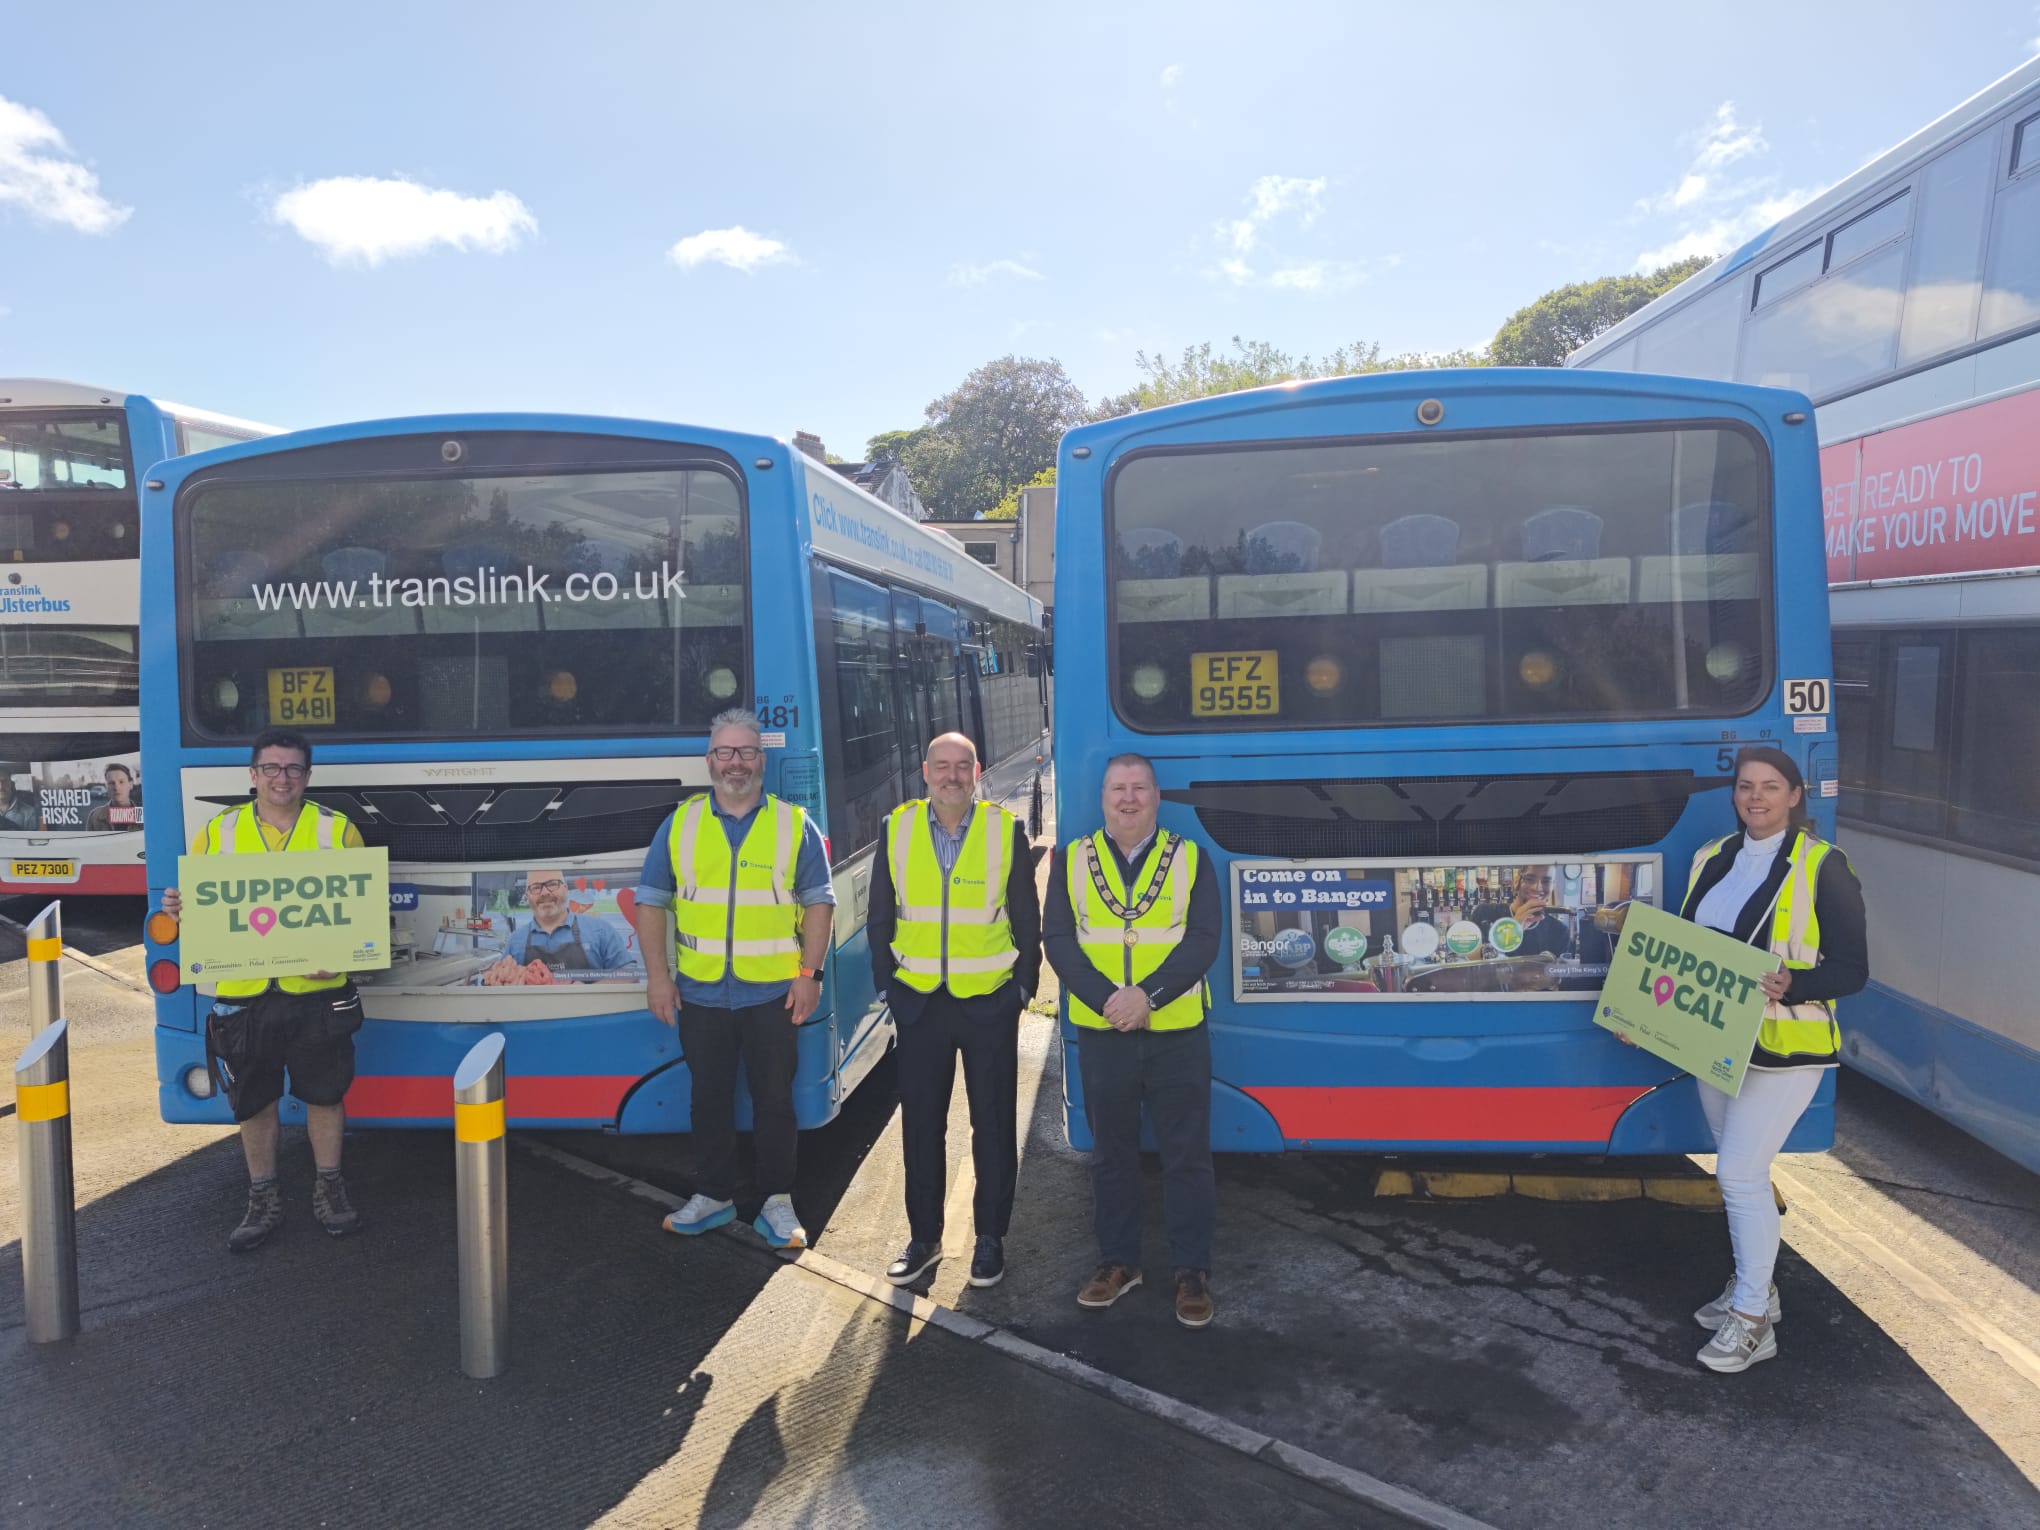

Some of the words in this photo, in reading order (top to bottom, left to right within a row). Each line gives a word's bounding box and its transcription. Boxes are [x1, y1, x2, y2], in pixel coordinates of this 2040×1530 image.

[1822, 481, 1857, 520] GET
[1863, 460, 1943, 513] READY
[1948, 452, 1982, 496] TO
[813, 492, 838, 534] Click
[1882, 507, 1947, 550] YOUR
[1955, 491, 2037, 542] MOVE
[0, 585, 41, 596] ranslink
[252, 561, 687, 611] www.translink.co.uk
[1209, 656, 1262, 682] EFZ
[281, 671, 327, 694] BFZ
[784, 695, 795, 703] 07
[1200, 685, 1271, 711] 9555
[1789, 681, 1825, 712] 50
[280, 697, 331, 720] 8481
[1760, 729, 1772, 738] 07
[424, 767, 496, 777] WRIGHT
[40, 789, 91, 807] SHARED
[42, 807, 83, 824] RISKS.
[16, 864, 38, 875] PEZ
[42, 863, 69, 875] 7300
[1243, 869, 1306, 883] Come
[1311, 869, 1341, 882] on
[196, 873, 373, 906] SUPPORT
[1243, 889, 1268, 904] in
[1273, 889, 1296, 904] to
[1301, 888, 1387, 907] Bangor
[229, 902, 352, 937] LOCAL
[1241, 938, 1290, 953] Bangor
[1627, 931, 1758, 1005] SUPPORT
[1638, 967, 1726, 1031] LOCAL
